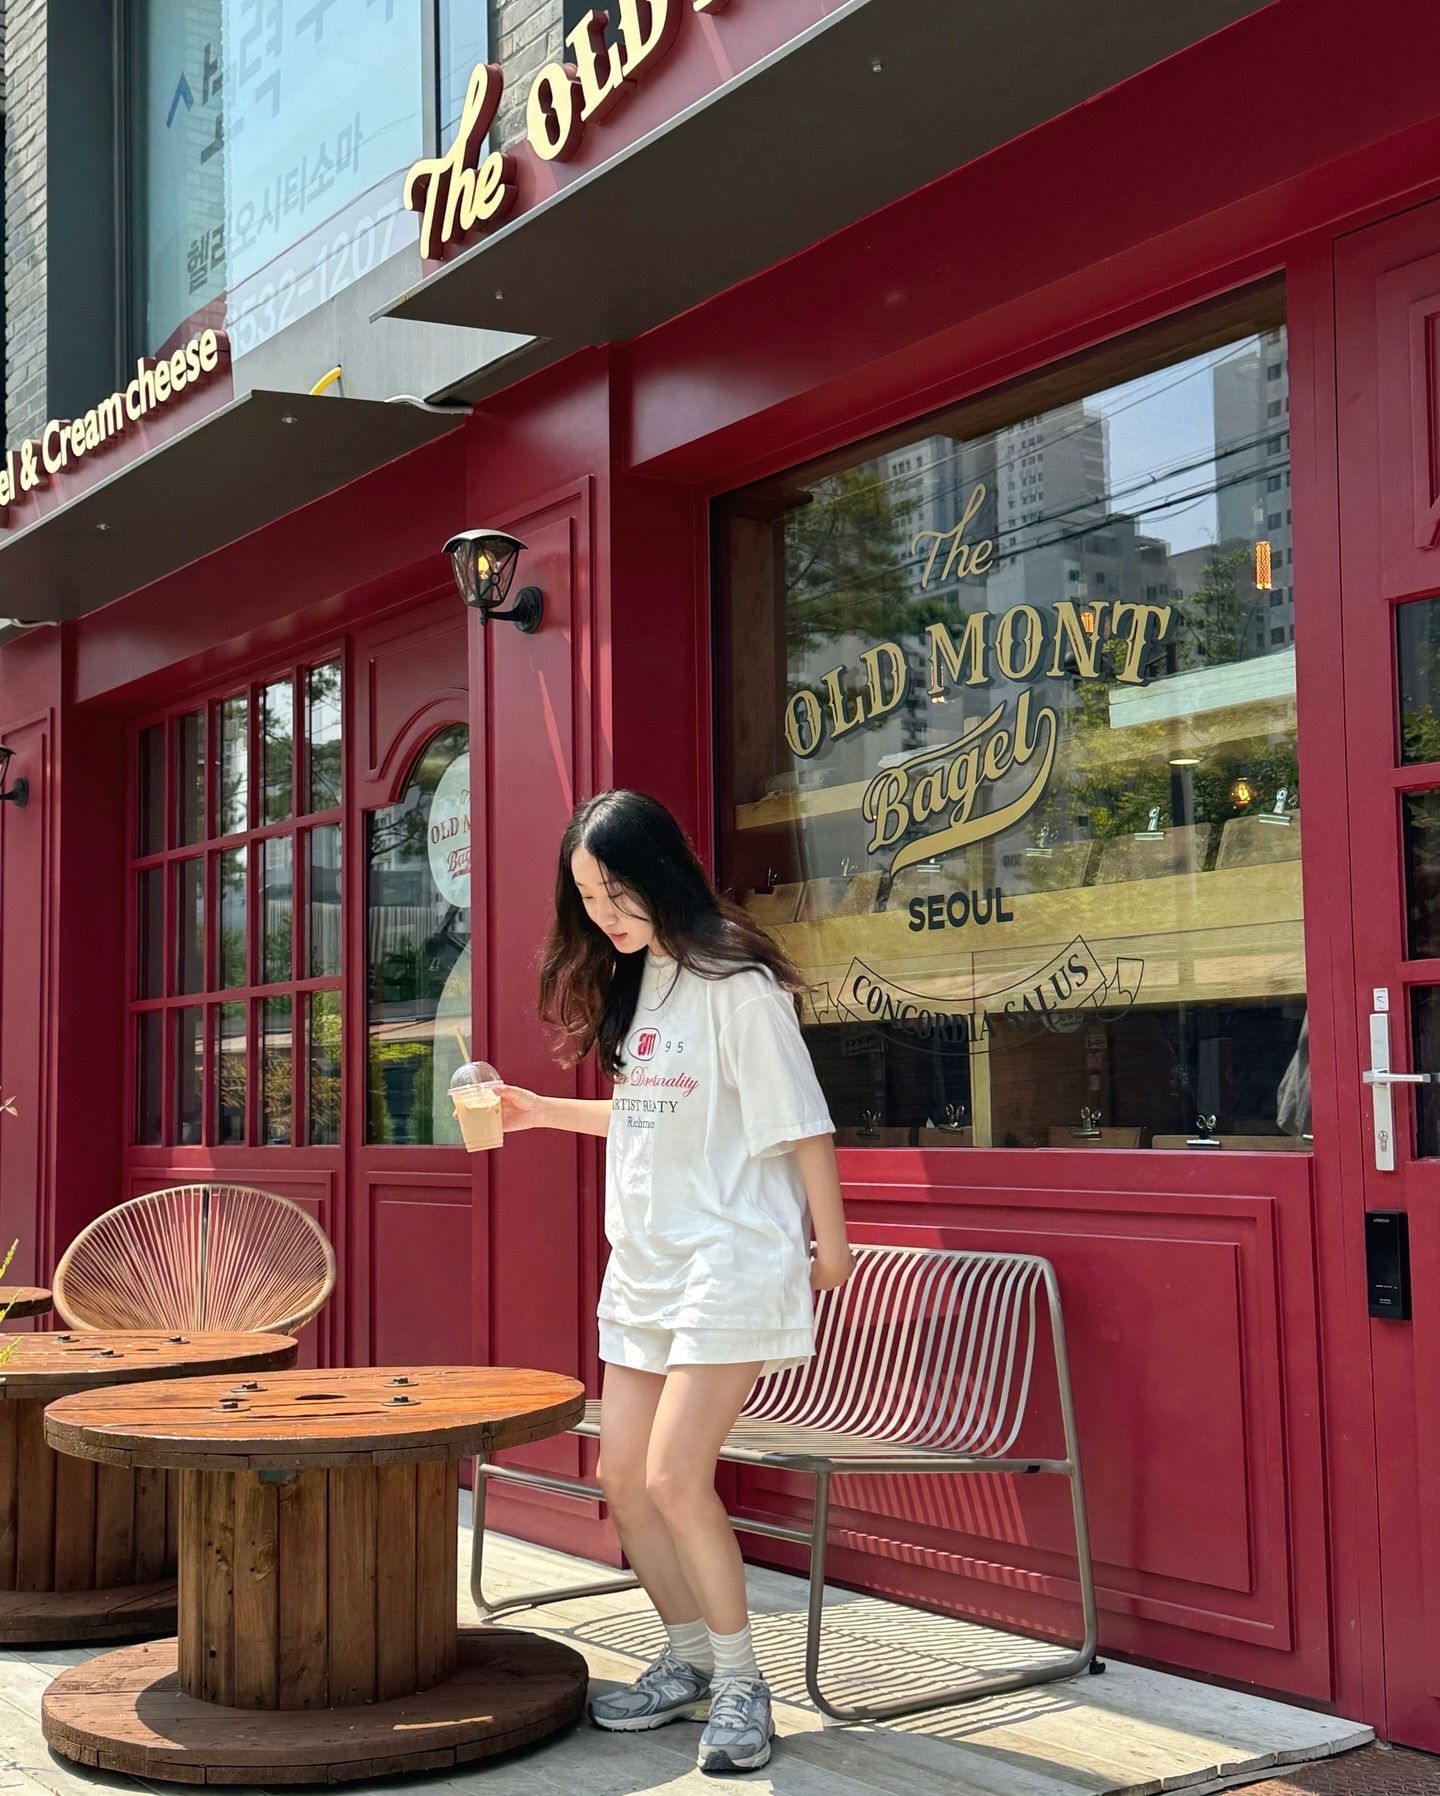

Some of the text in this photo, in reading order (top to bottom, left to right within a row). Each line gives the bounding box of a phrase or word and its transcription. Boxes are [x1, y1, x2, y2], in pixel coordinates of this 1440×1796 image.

[403, 0, 668, 260] The OLD
[20, 438, 40, 491] &
[42, 418, 124, 474] Cream
[126, 328, 219, 421] cheese
[911, 483, 994, 589] The
[784, 599, 1175, 759] OLD MONT
[430, 816, 460, 845] OLD
[862, 688, 1058, 880] Bagel
[908, 887, 1014, 932] SEOUL
[852, 953, 1090, 1043] CONCORDIA SALUS
